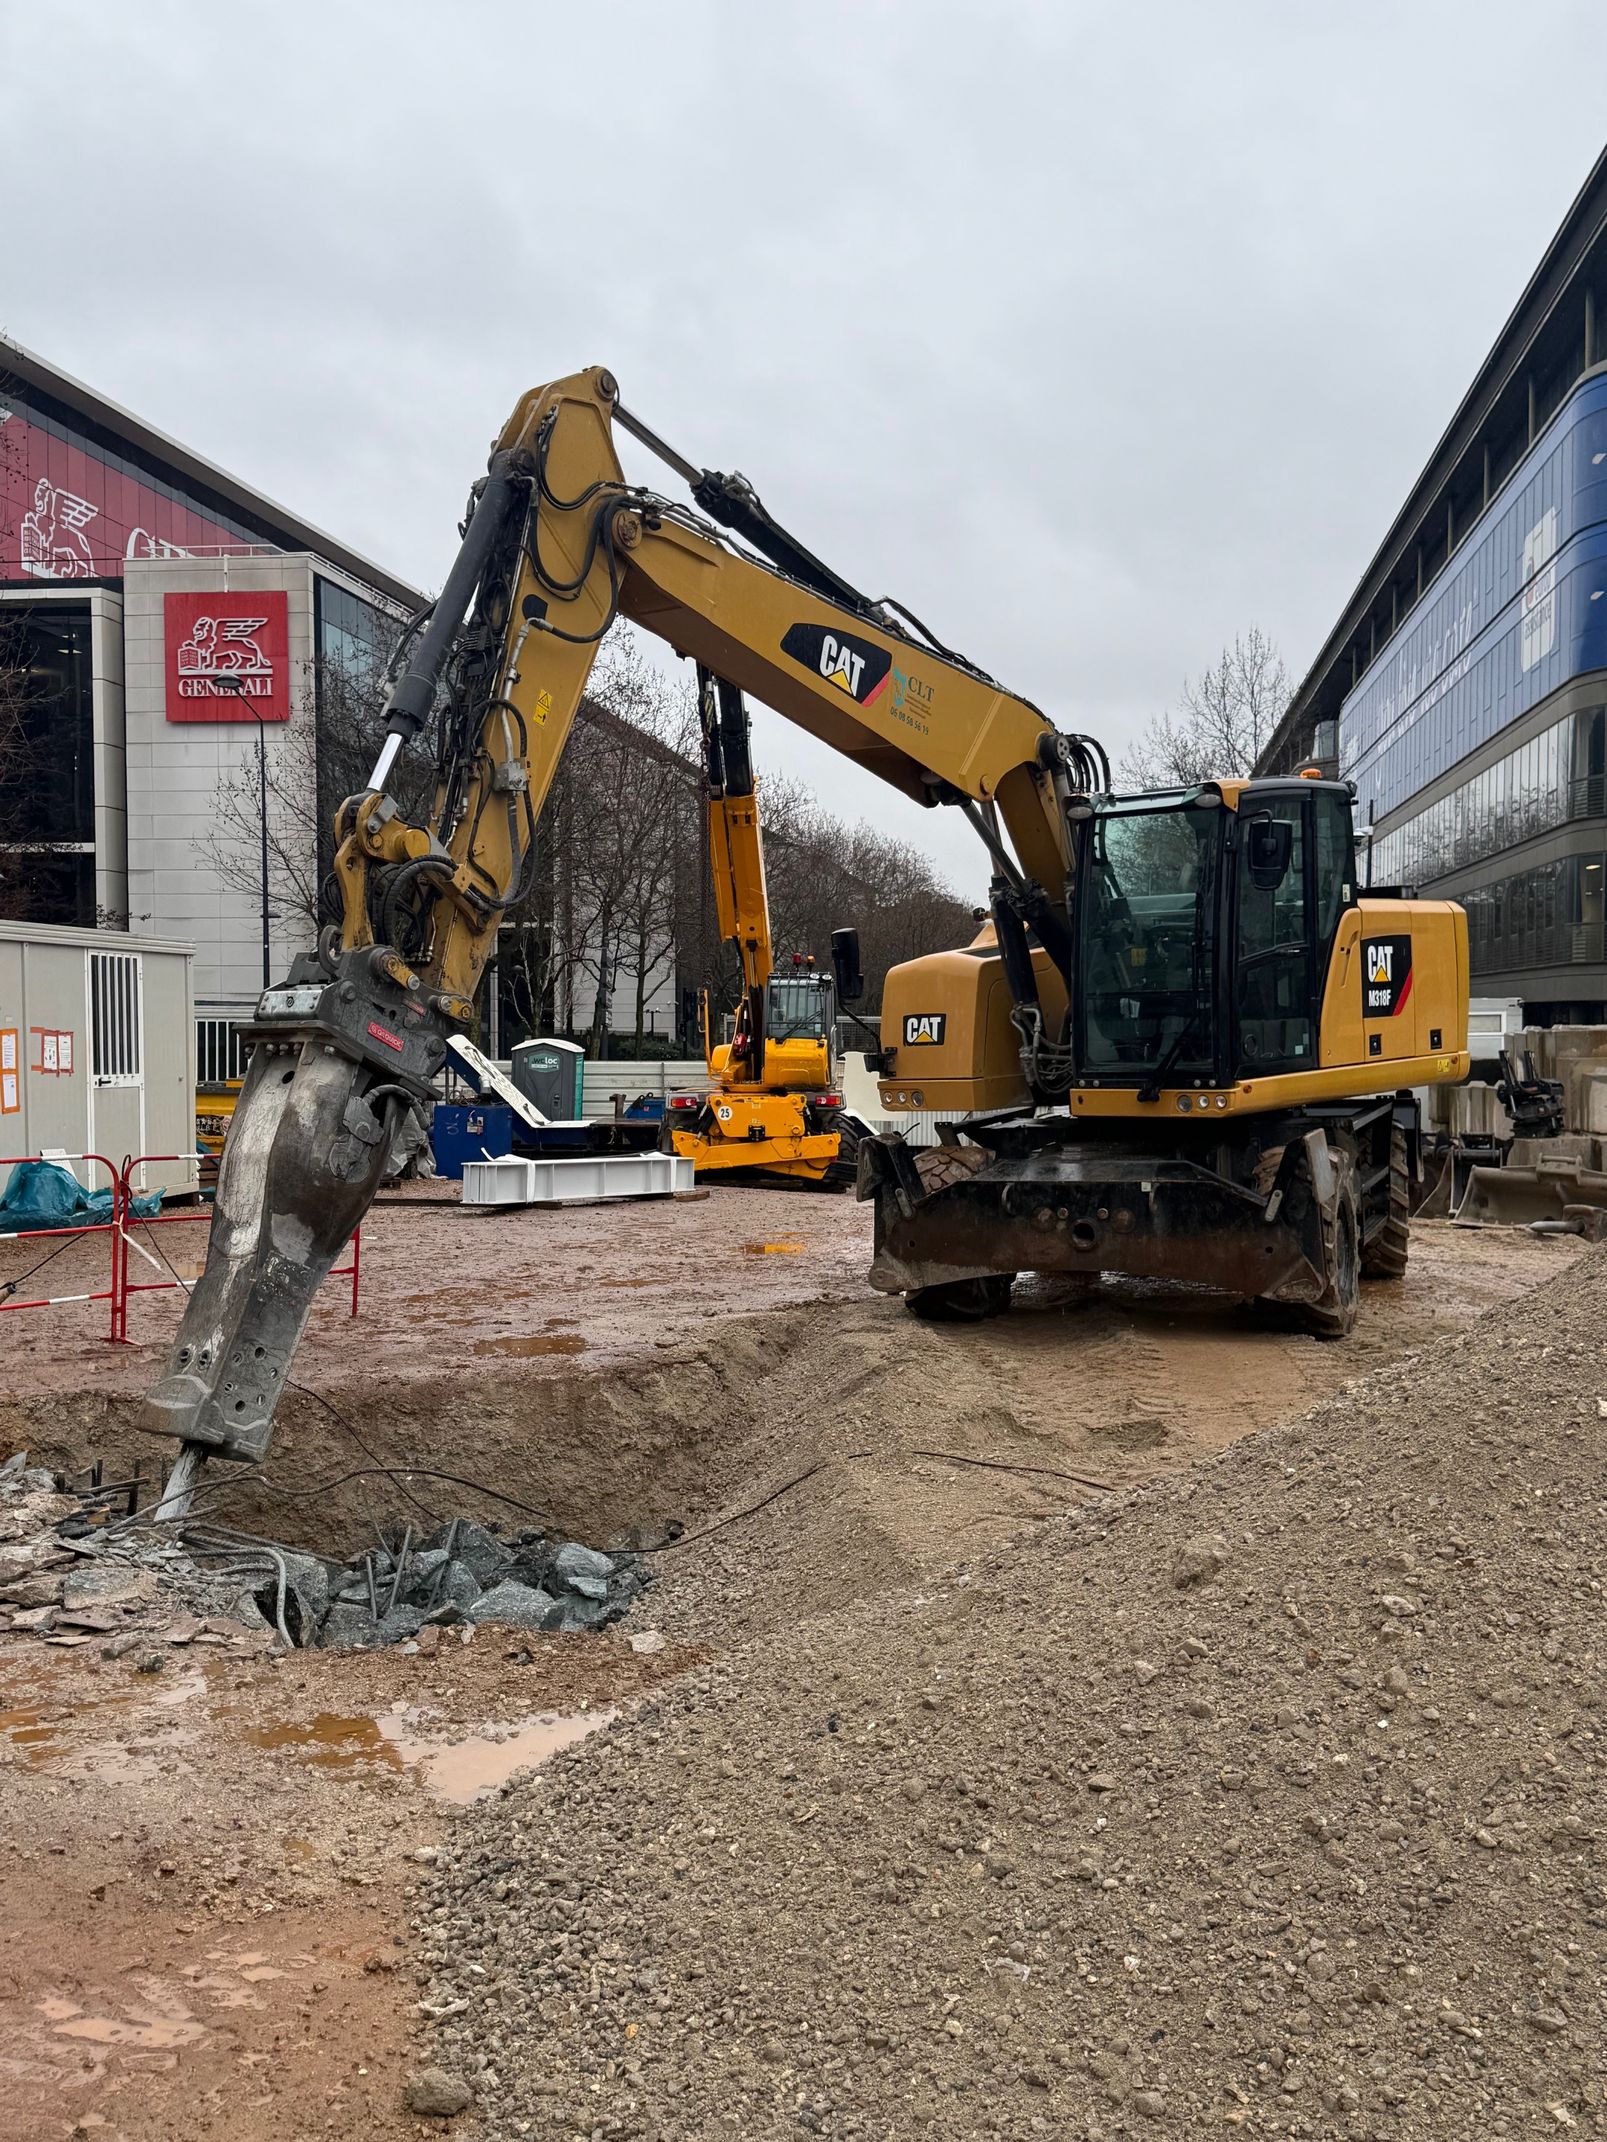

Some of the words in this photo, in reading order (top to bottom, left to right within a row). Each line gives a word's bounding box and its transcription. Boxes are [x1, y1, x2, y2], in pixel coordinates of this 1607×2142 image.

[819, 635, 866, 697] CAT
[908, 676, 935, 702] CLT
[1367, 945, 1393, 982] CAT
[1368, 989, 1392, 1007] M318F
[906, 1016, 941, 1043] CAT
[720, 1108, 730, 1118] 25
